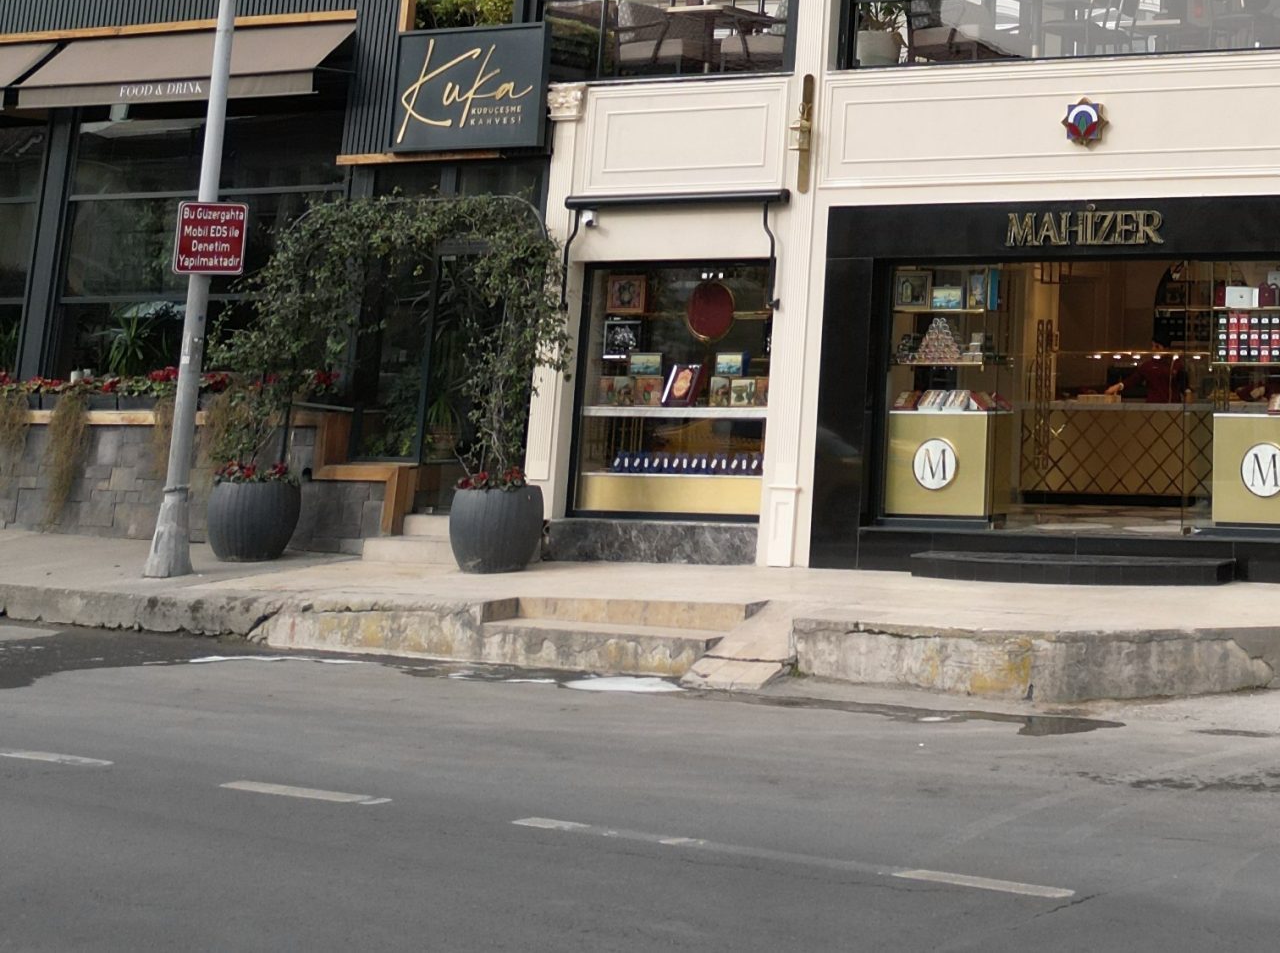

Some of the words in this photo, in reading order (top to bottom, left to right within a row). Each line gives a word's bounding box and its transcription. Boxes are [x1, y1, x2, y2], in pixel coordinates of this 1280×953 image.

[119, 84, 153, 98] FOOD
[155, 83, 163, 96] &
[166, 81, 203, 95] DRINK
[396, 38, 533, 144] Kuka
[183, 207, 195, 220] Bu
[196, 207, 244, 224] Güzergahta
[184, 225, 209, 238] Mobil
[209, 225, 228, 238] EDS
[228, 226, 240, 238] ile
[1005, 203, 1165, 247] MAHİZER
[191, 239, 231, 252] Denetim
[178, 253, 241, 270] Yapılmaktadır
[920, 448, 947, 481] M
[1250, 453, 1280, 487] M
